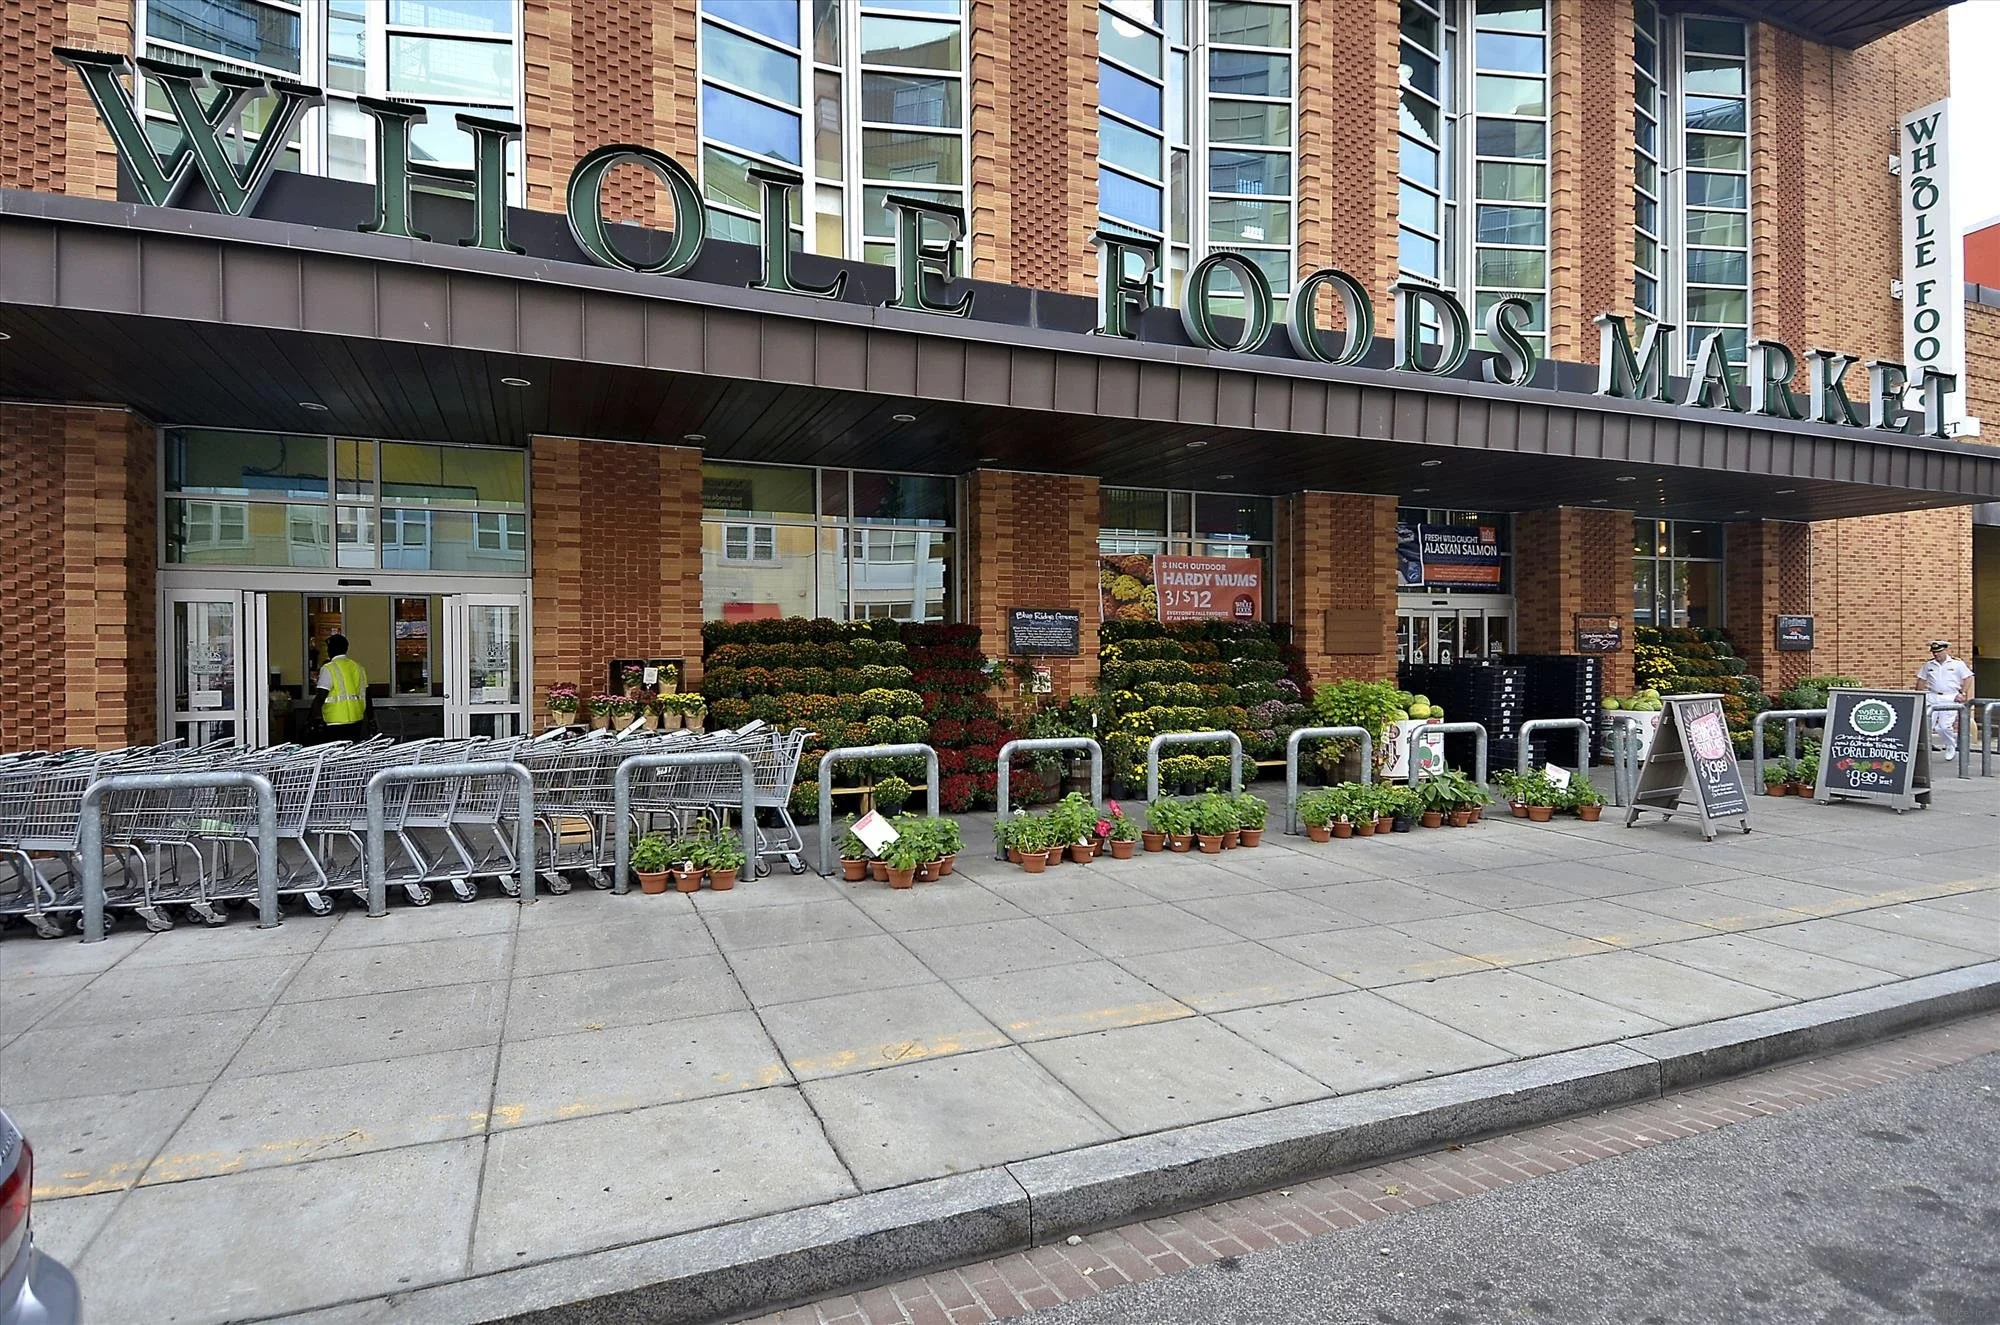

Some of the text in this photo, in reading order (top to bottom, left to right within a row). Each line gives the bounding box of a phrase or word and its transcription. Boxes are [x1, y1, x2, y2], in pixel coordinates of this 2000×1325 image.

[52, 46, 1958, 440] WHOLE FOODS MARKET
[1905, 111, 1942, 378] WHOLE FOO
[1424, 534, 1478, 544] FRESH WILD CAUGHT
[1424, 543, 1498, 556] ALASKAN SALMON
[1190, 563, 1226, 571] OUTDOOR
[1162, 572, 1258, 587] HARDY MUMS
[1016, 611, 1033, 620] Blue
[1034, 612, 1054, 622] Ridge
[1832, 746, 1909, 763] FLORAL BOUQUETS
